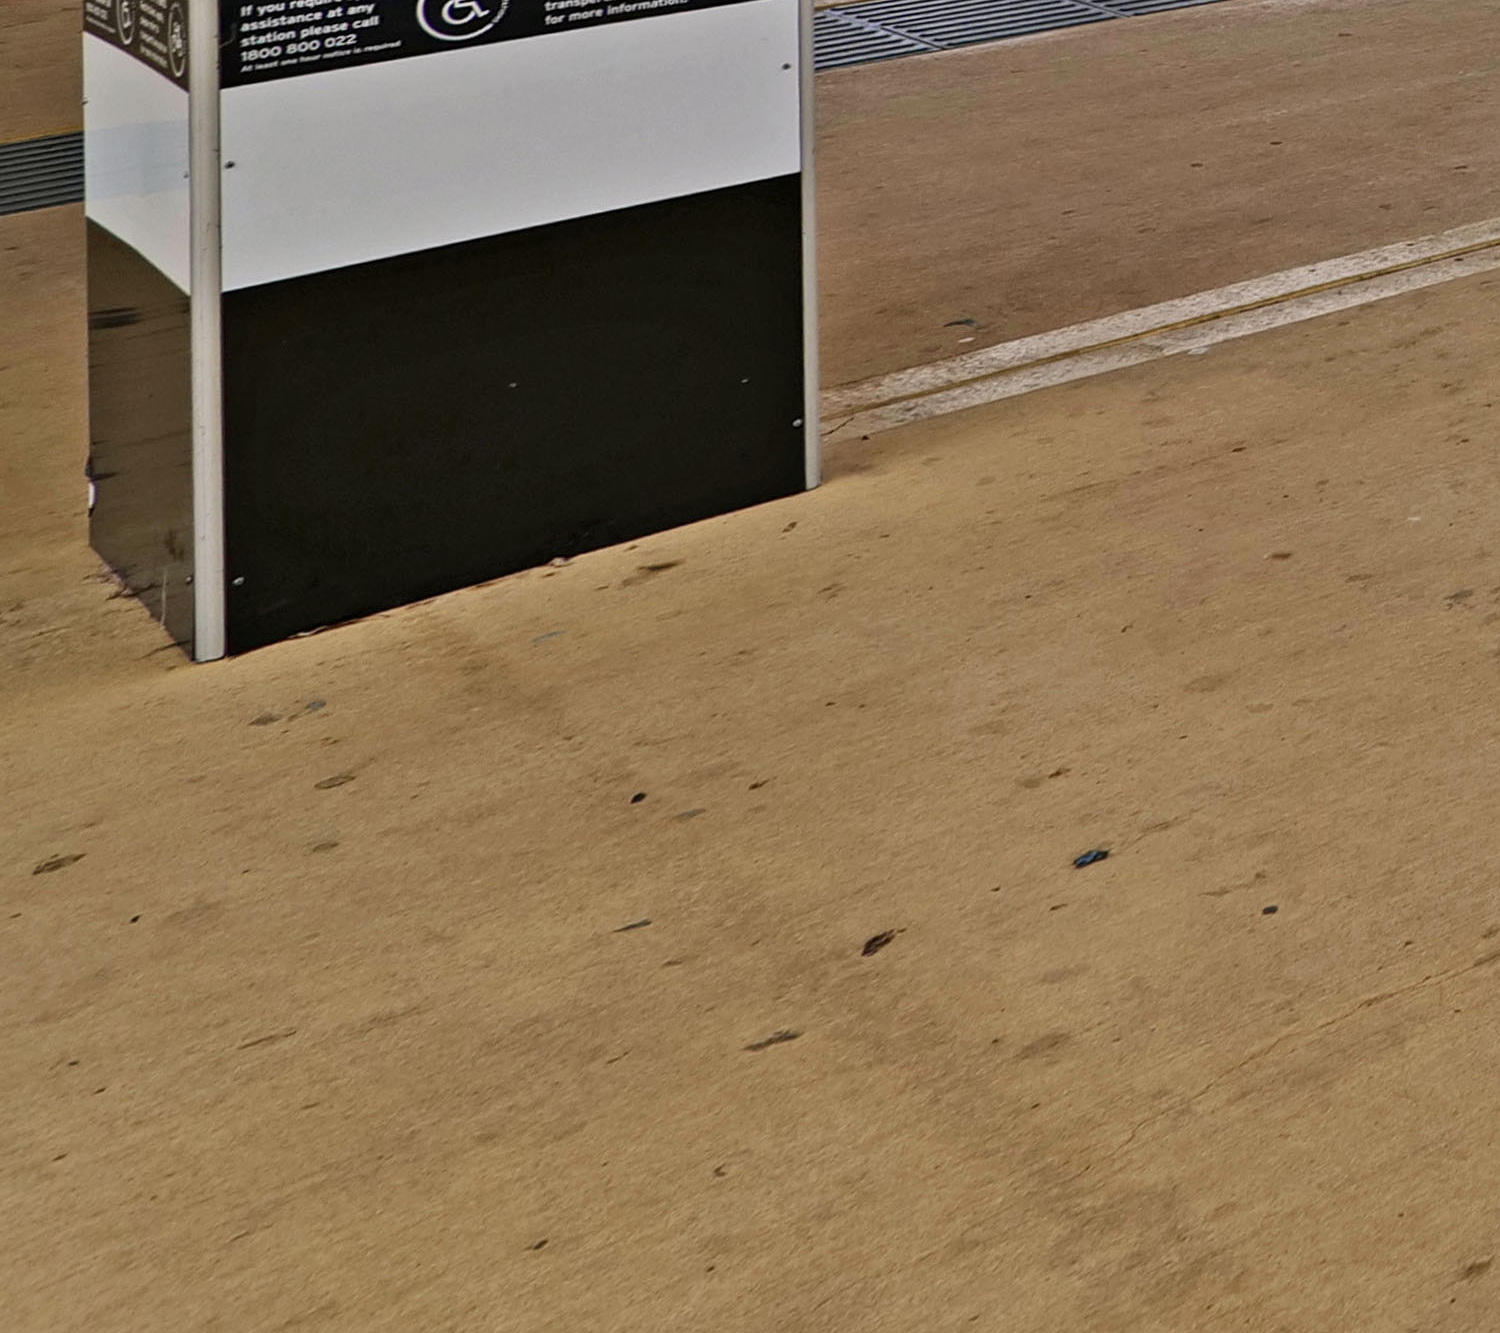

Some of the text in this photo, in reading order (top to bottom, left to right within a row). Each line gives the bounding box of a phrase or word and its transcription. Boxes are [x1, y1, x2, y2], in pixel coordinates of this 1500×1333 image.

[240, 6, 254, 17] If
[257, 1, 285, 16] you
[240, 4, 375, 32] assistance at any
[545, 15, 565, 25] for
[569, 9, 604, 21] more
[240, 17, 379, 46] station please call
[241, 35, 357, 61] 1800 800 022
